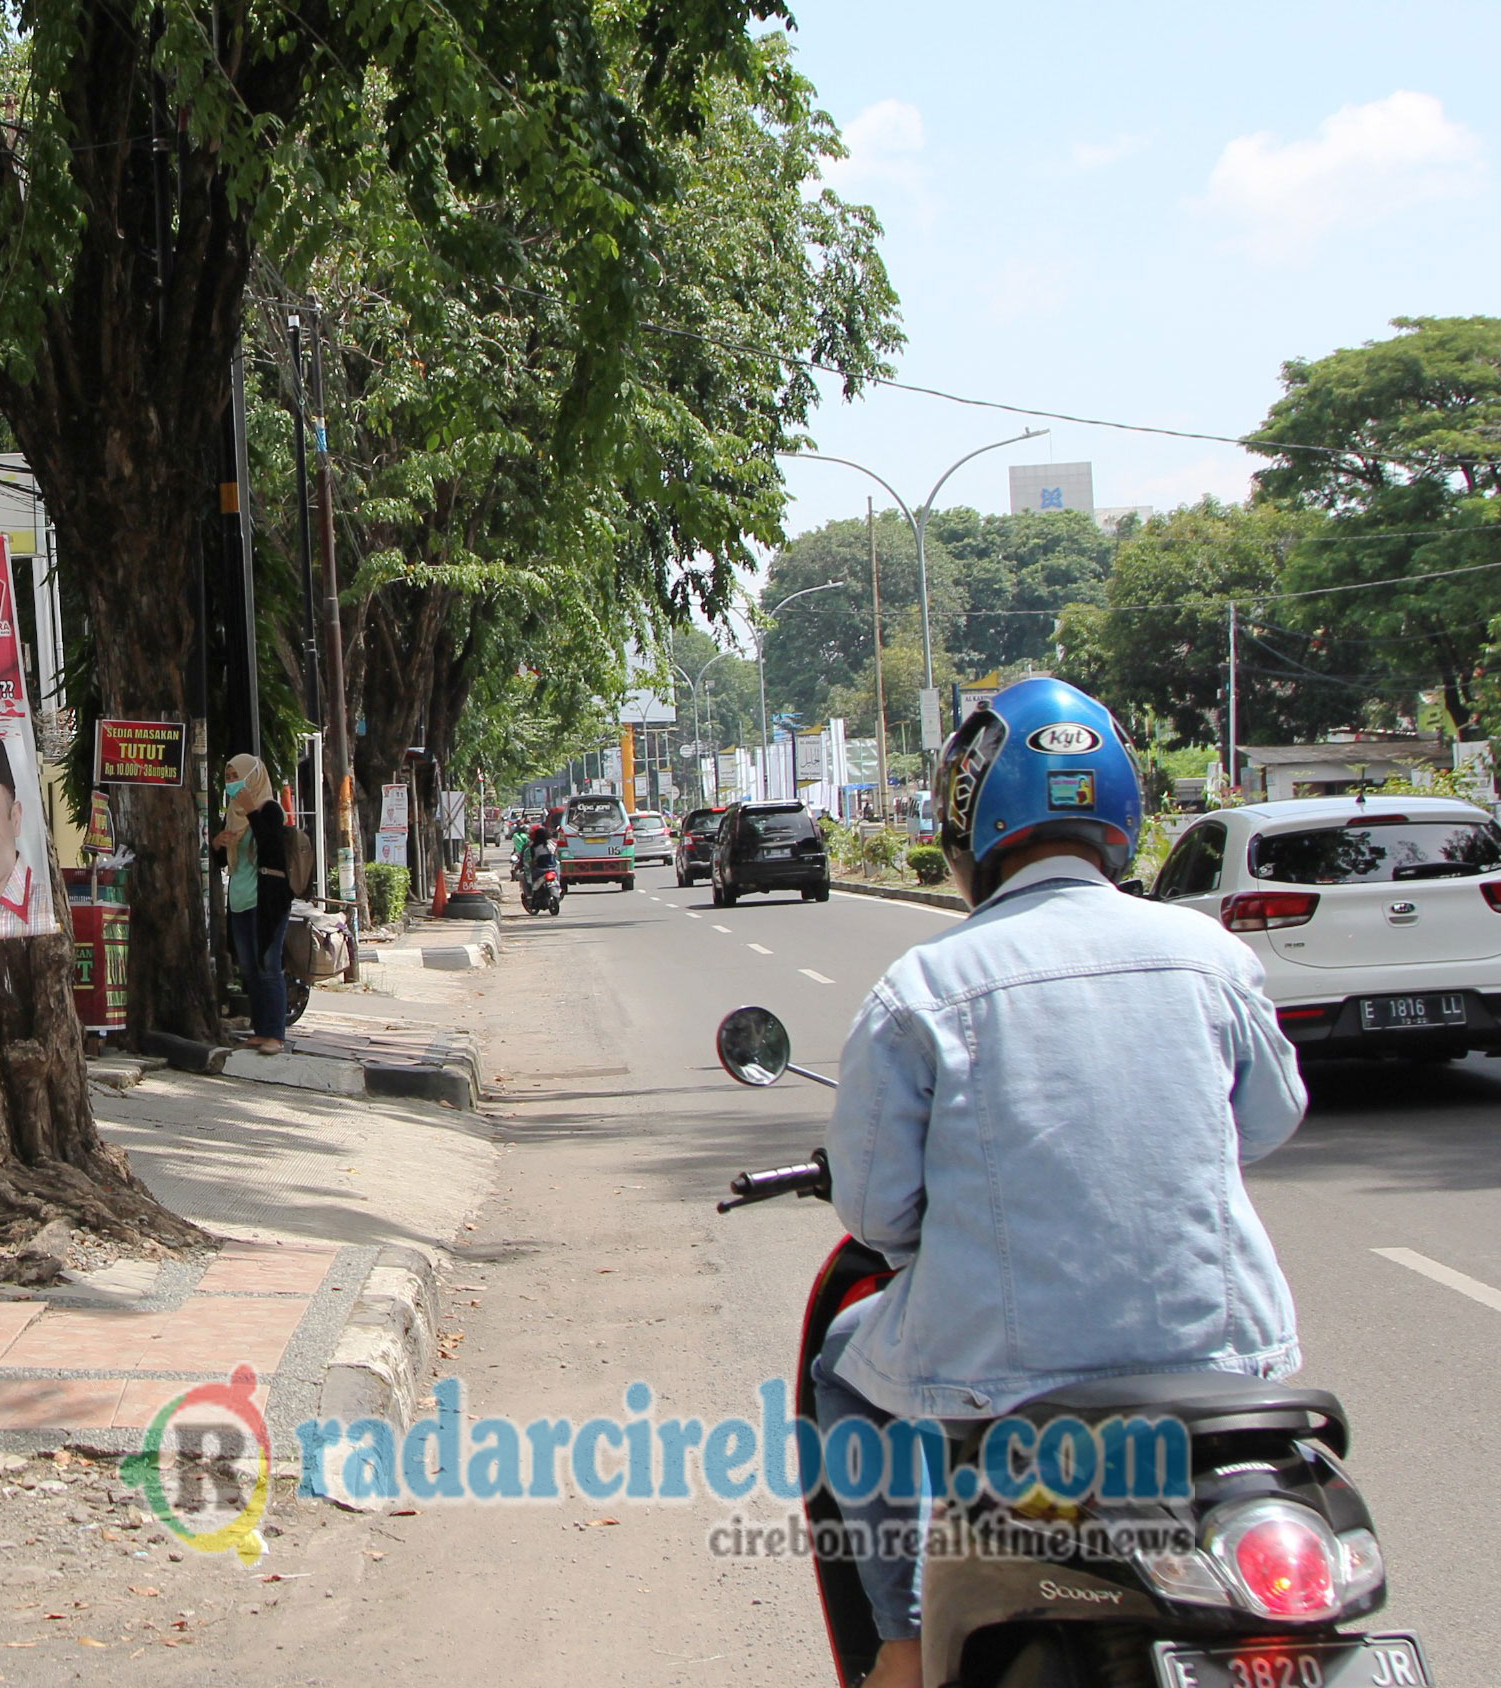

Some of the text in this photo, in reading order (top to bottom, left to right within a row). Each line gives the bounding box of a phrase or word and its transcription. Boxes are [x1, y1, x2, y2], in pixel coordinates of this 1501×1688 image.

[106, 727, 180, 740] SEDIA MASAKAN
[119, 743, 166, 760] TUTUT
[104, 762, 116, 776] Rp.
[116, 763, 139, 777] 10.000
[1364, 996, 1462, 1019] E 1816 LL
[1214, 1461, 1278, 1476] HONDA
[1228, 1654, 1324, 1688] 3820
[1371, 1650, 1418, 1686] JR
